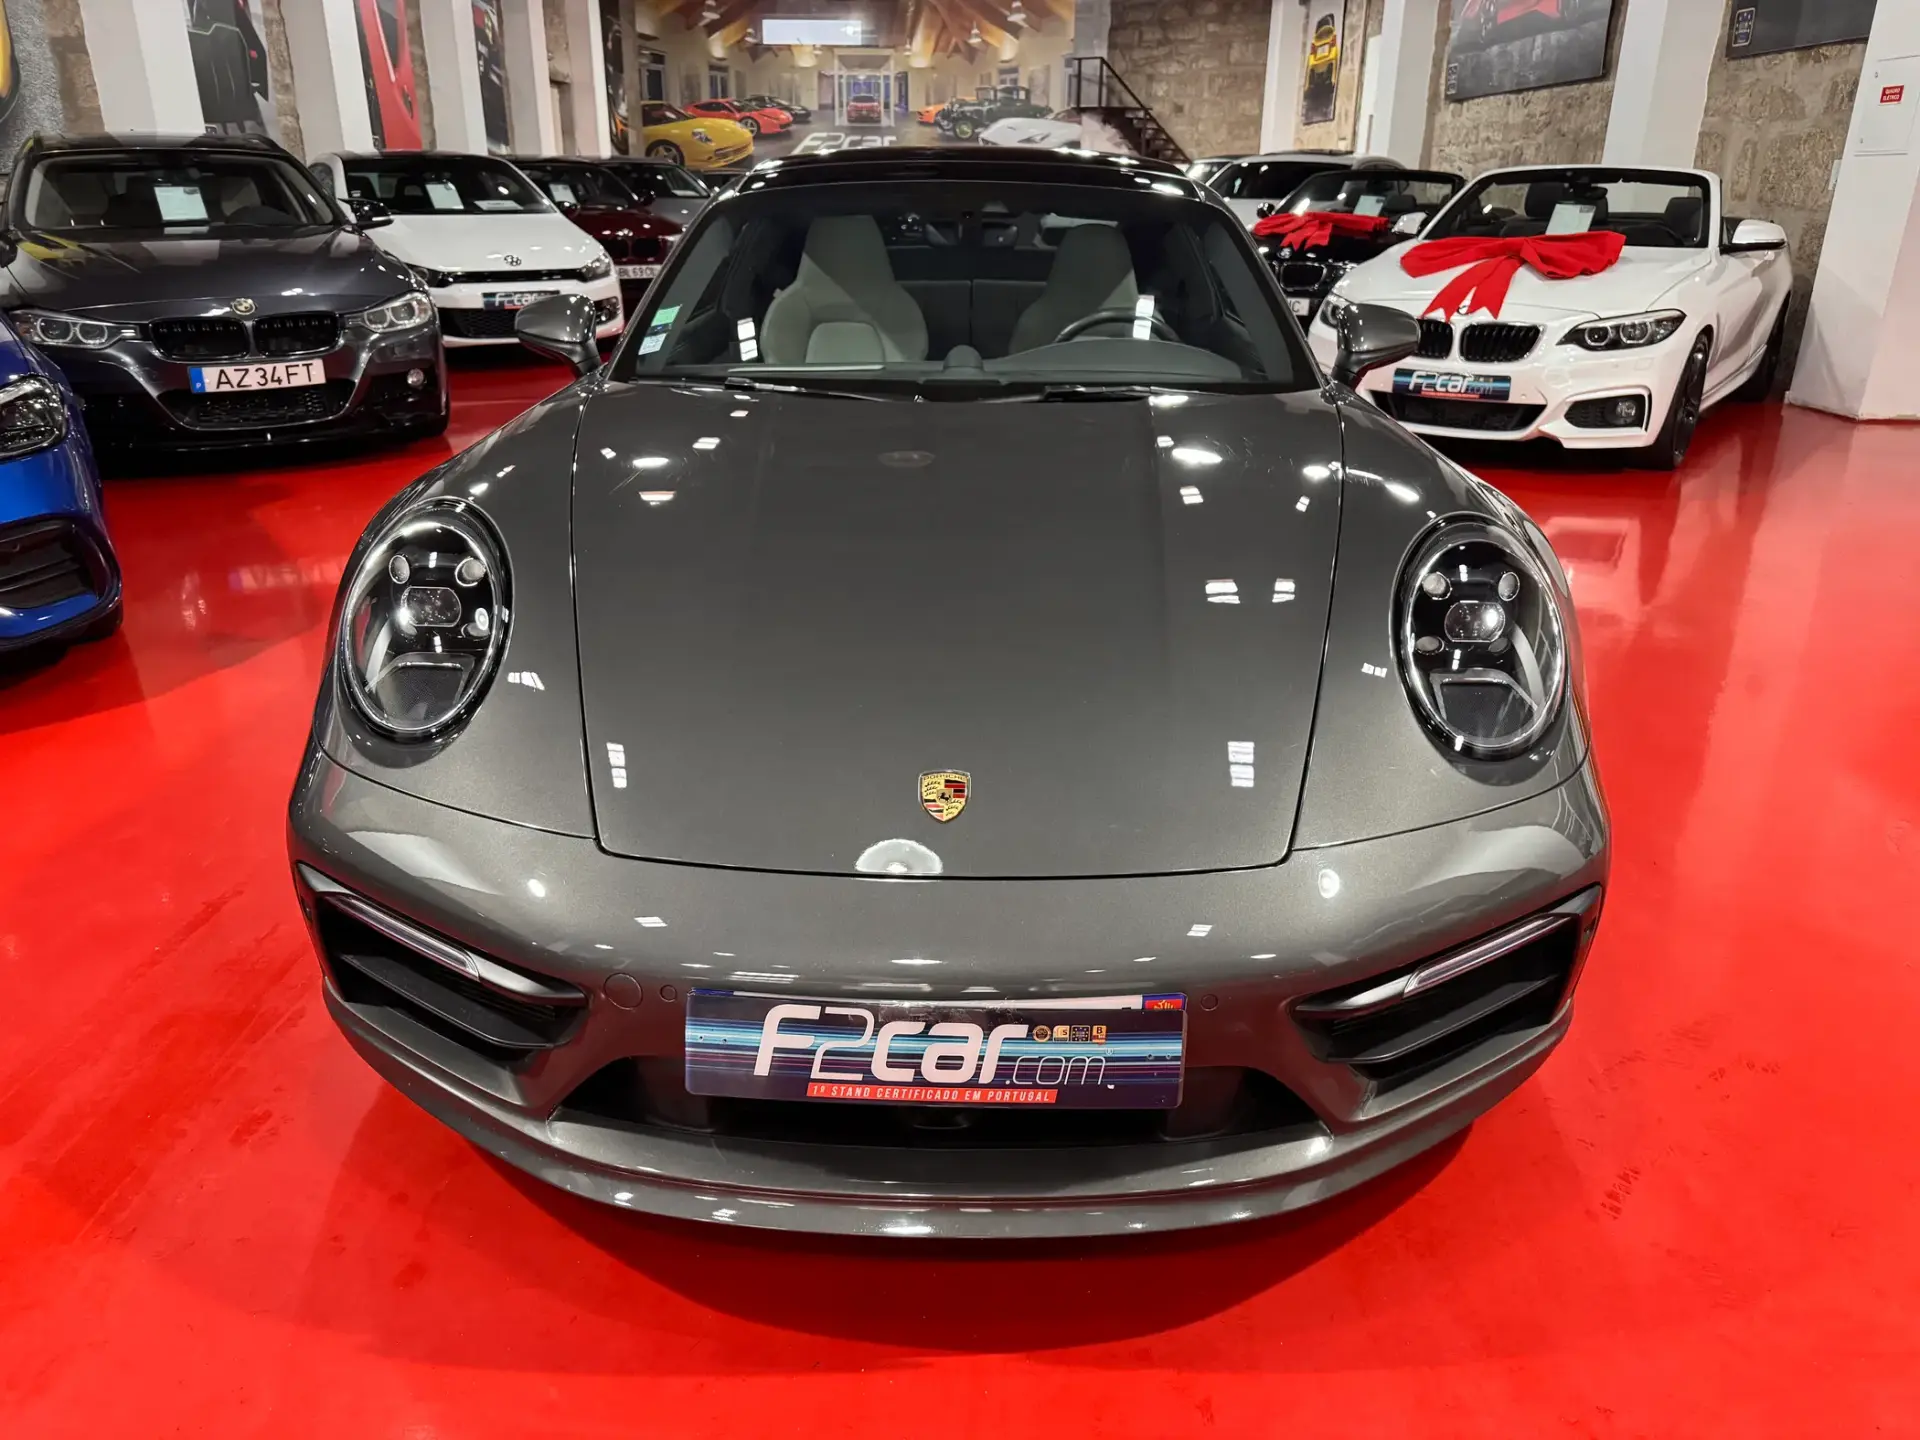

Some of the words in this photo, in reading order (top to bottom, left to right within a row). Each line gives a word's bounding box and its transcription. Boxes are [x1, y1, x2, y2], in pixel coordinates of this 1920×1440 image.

[831, 1086, 871, 1098] STAND
[876, 1087, 959, 1100] CERTIFICADO
[964, 1090, 982, 1100] EM
[987, 1091, 1050, 1102] PORTUGAL
